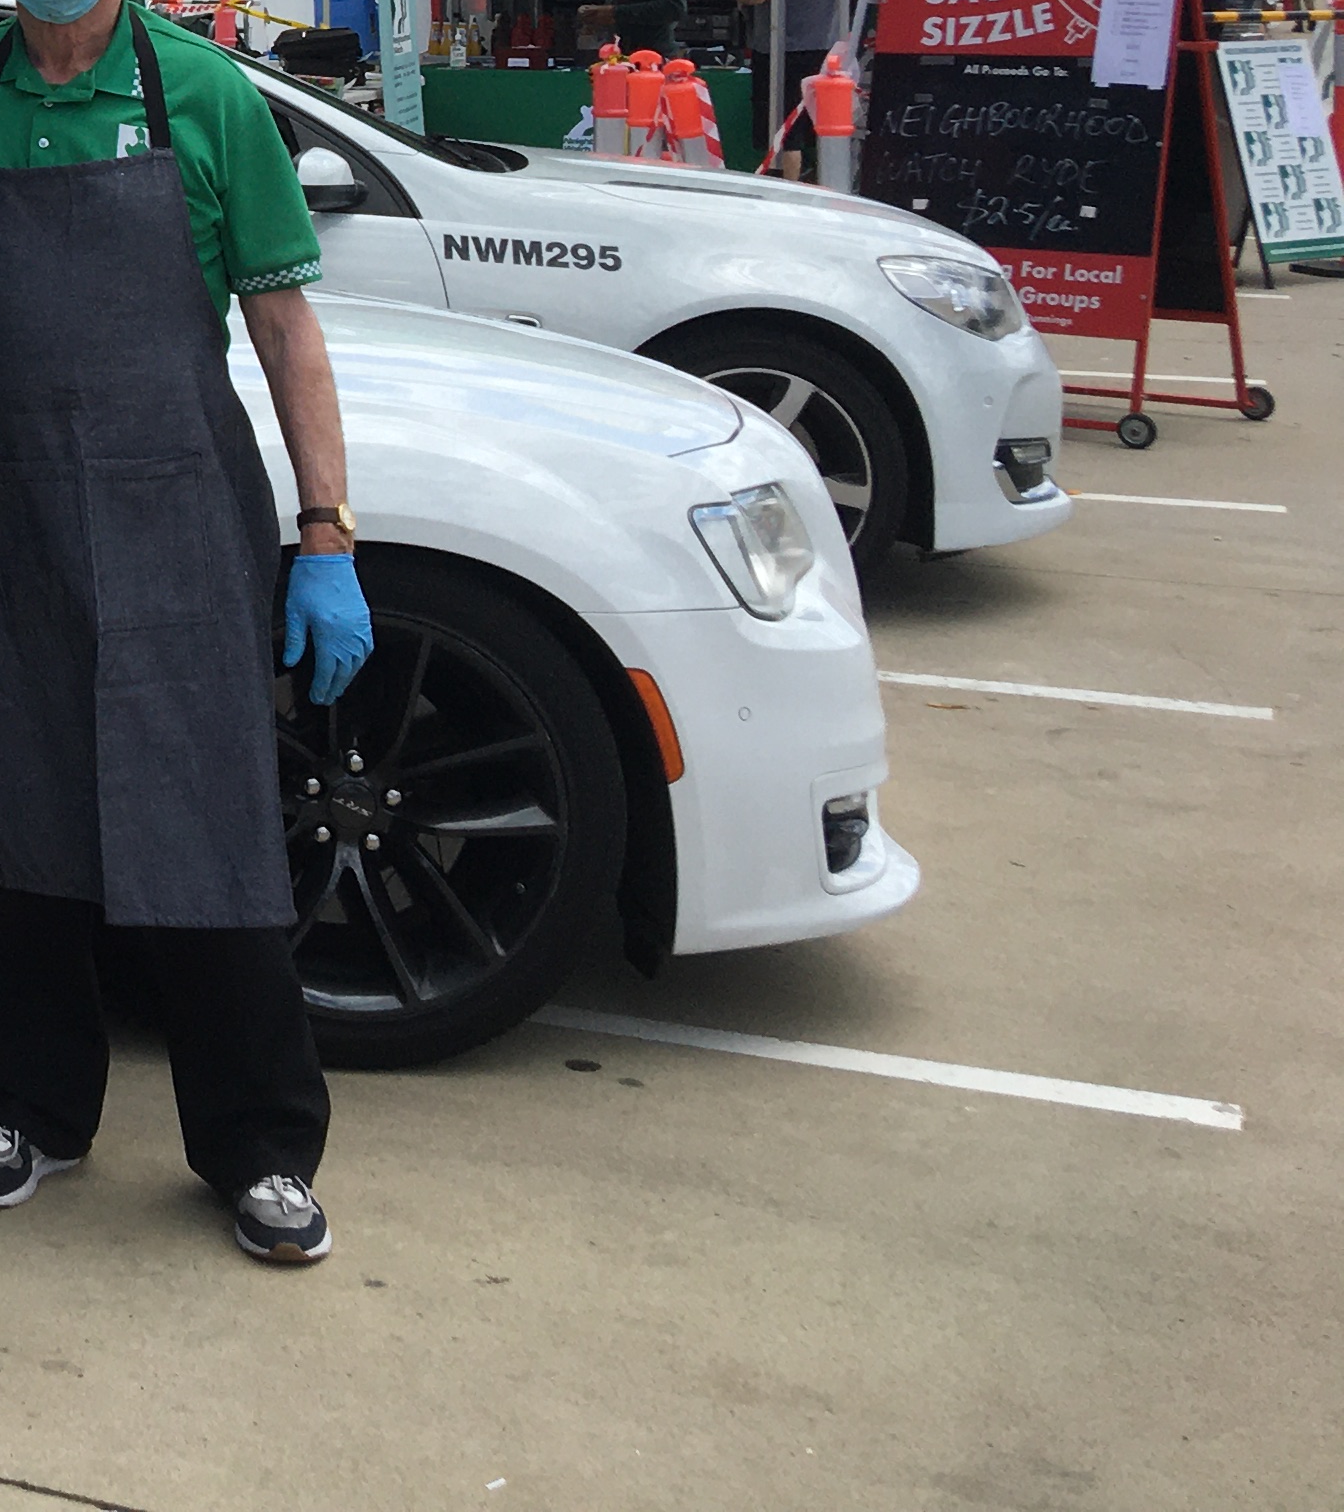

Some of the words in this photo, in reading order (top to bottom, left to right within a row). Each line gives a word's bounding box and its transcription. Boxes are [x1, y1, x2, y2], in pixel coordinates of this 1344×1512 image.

[920, 1, 1055, 47] SIZZLE
[1032, 66, 1051, 77] Go
[880, 102, 1149, 143] NEIGHBOURHOOD
[1014, 154, 1109, 194] RYDE
[443, 234, 622, 272] NWM295
[1020, 261, 1058, 280] For
[1064, 263, 1124, 284] Local
[1019, 286, 1101, 312] Groups
